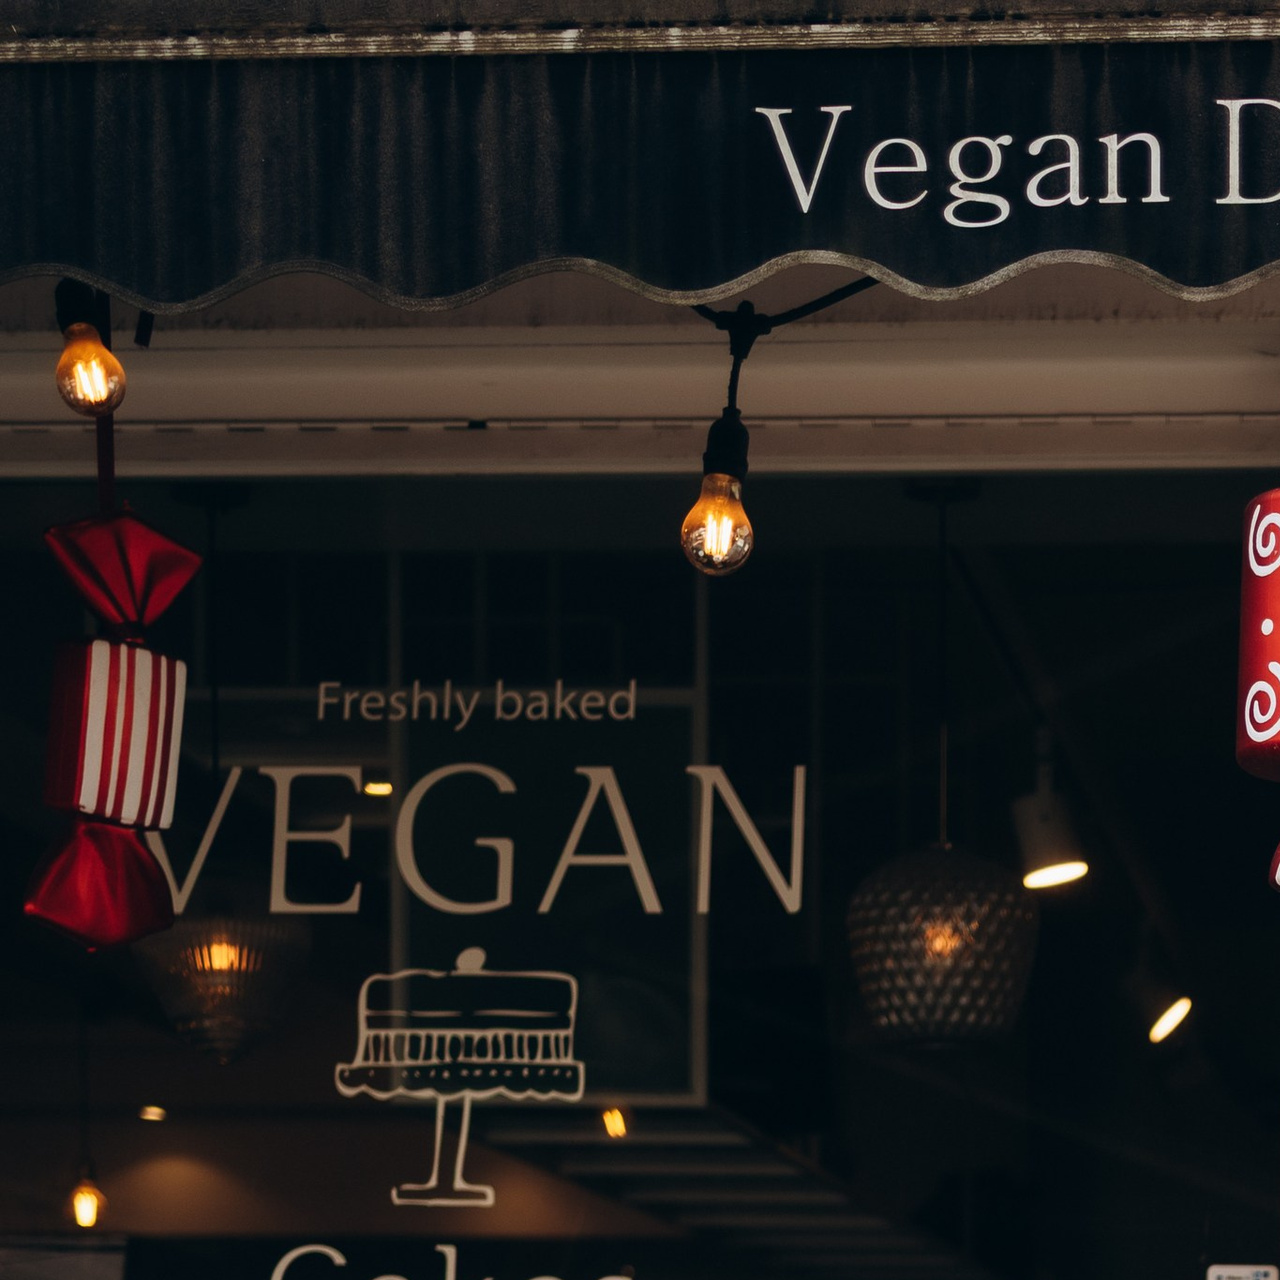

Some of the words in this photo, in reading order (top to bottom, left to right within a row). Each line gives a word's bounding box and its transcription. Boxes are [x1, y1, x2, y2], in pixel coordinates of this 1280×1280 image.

[754, 105, 1170, 228] Vegan
[316, 682, 481, 731] Freshly
[494, 680, 638, 721] baked
[144, 763, 806, 915] VEGAN
